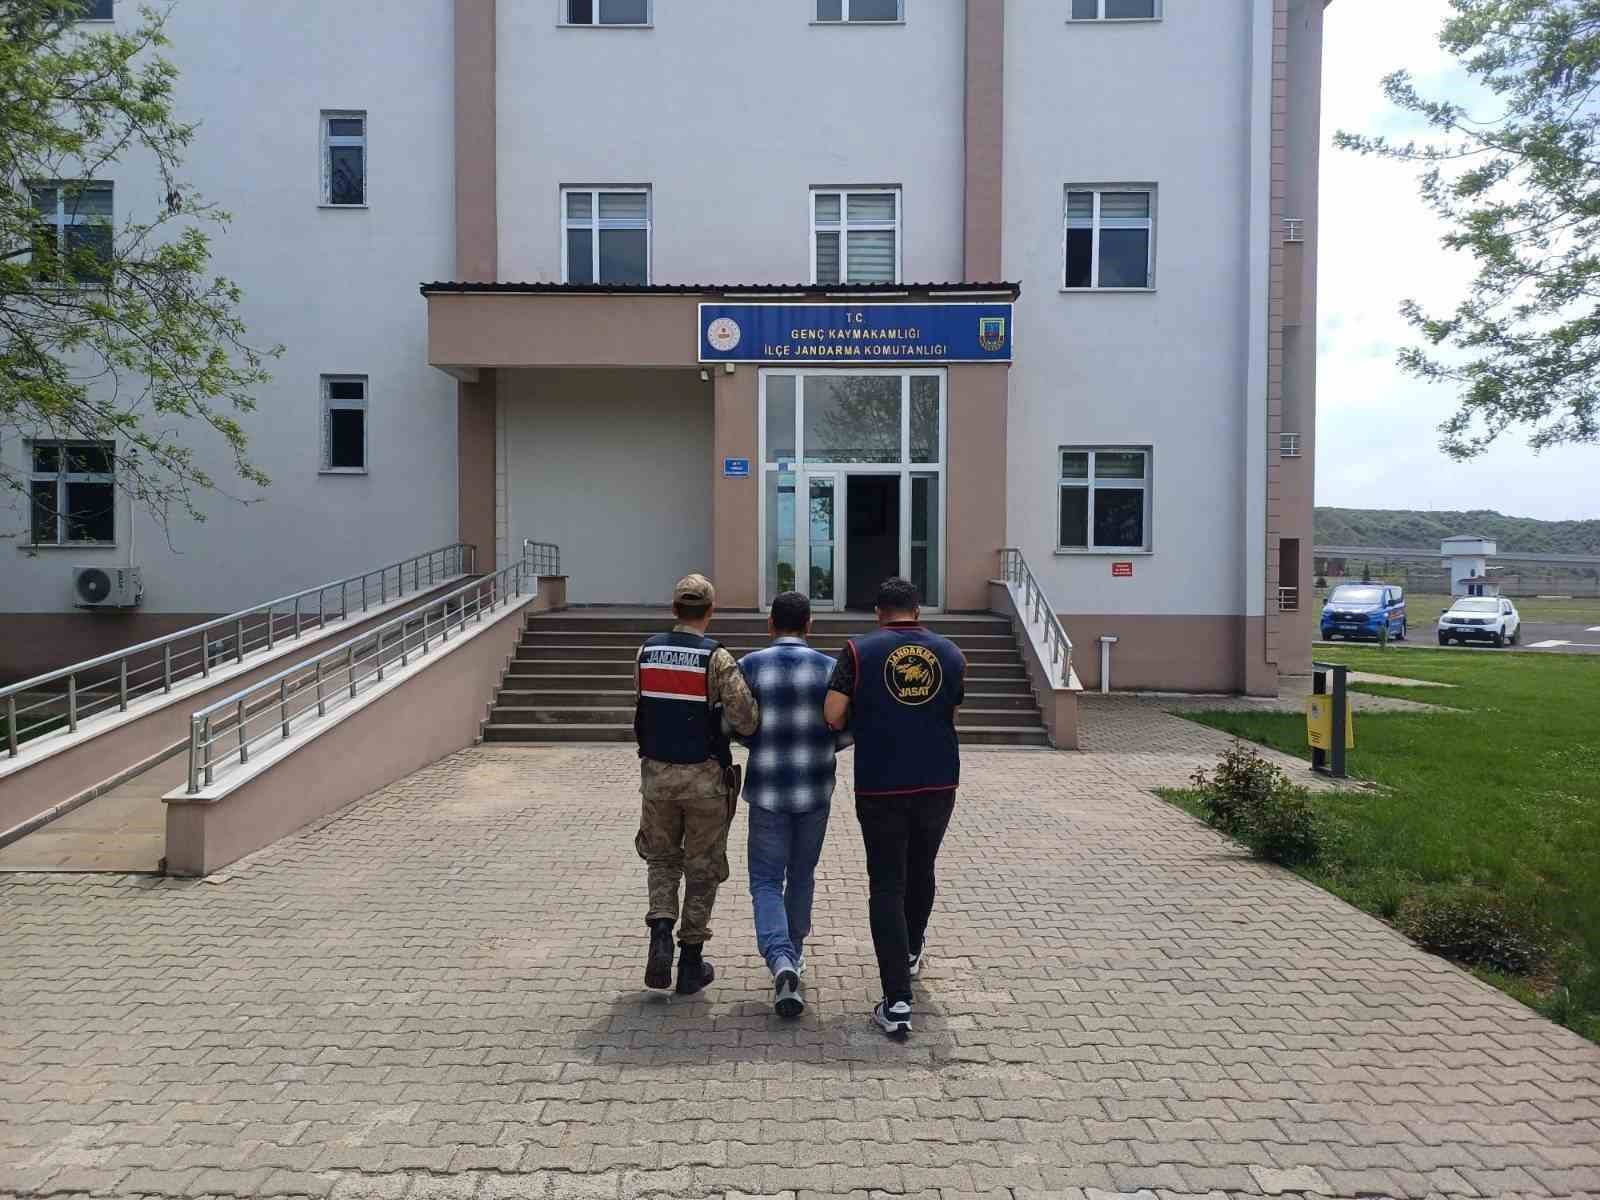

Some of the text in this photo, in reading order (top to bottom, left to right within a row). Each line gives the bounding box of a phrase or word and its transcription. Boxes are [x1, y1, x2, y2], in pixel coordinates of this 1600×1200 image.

[791, 328, 920, 341] GENÇ KAYMAKAMLIĞI
[763, 343, 946, 357] İLÇE JANDARMA KOMUTANLIĞI
[648, 650, 700, 666] JANDARMA
[898, 686, 929, 698] JASAT
